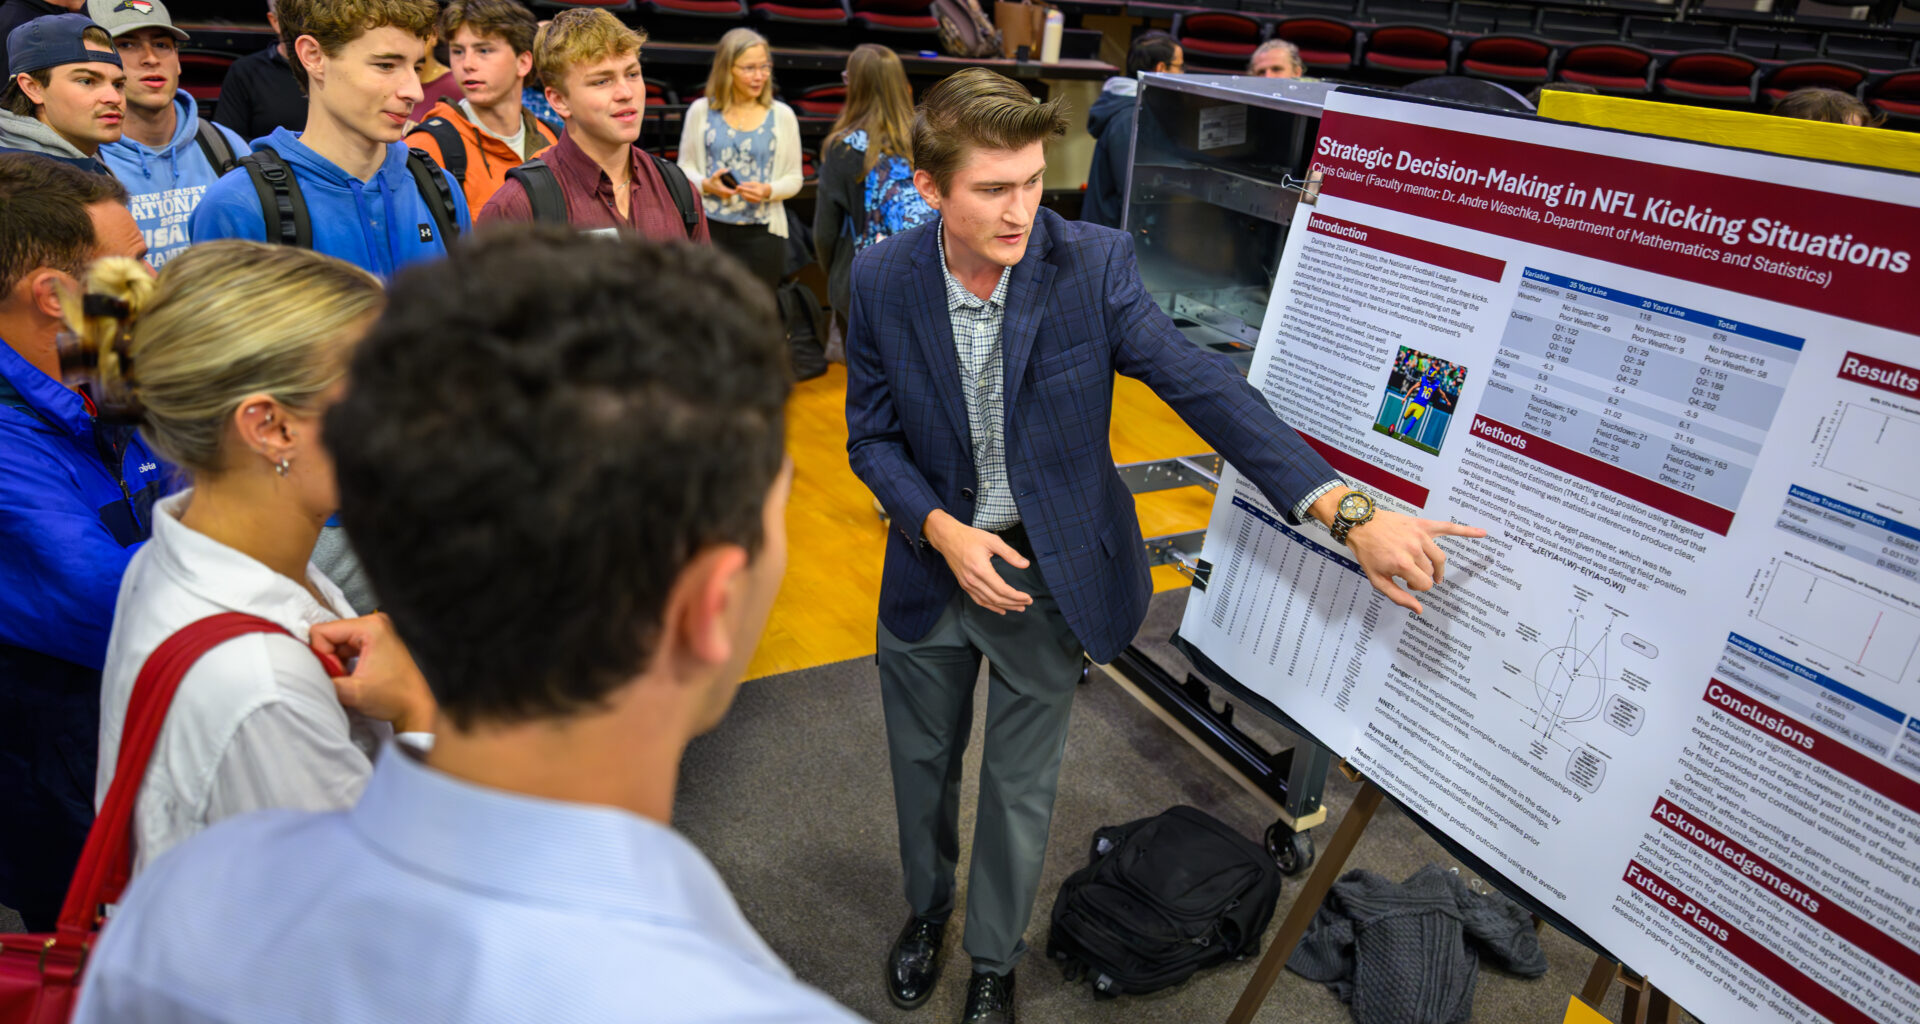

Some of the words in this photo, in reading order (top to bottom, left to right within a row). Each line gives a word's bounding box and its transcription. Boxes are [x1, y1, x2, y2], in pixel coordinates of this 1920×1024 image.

[131, 194, 202, 221] ATIONA
[132, 192, 160, 204] NEW
[162, 185, 206, 200] JERSEY
[1317, 136, 1393, 170] Strategic
[1395, 150, 1564, 207] Decision-Making
[1562, 182, 1587, 208] in
[1590, 187, 1637, 218] NFL
[1642, 197, 1746, 244] Kicking
[1748, 218, 1911, 273] Situations
[1309, 216, 1368, 242] Introduction
[1312, 162, 1336, 176] Chris
[1336, 167, 1366, 182] Guider
[1366, 173, 1404, 193] (Faculty
[1403, 183, 1441, 199] mentor:
[1441, 189, 1456, 203] Dr.
[1456, 193, 1489, 210] Andre
[1490, 199, 1541, 223] Waschka,
[1543, 211, 1615, 238] Department
[1616, 228, 1631, 241] of
[1630, 229, 1720, 261] Mathematics
[1721, 252, 1752, 268] and
[1752, 256, 1832, 289] Statistics)
[1524, 269, 1550, 282] Variable
[1578, 283, 1593, 293] Yard
[1593, 287, 1608, 296] Line
[1518, 292, 1542, 303] Weather
[1642, 300, 1652, 308] 20
[1653, 302, 1669, 313] Yard
[1669, 307, 1685, 317] Line
[1718, 319, 1737, 331] Total
[1842, 357, 1919, 392] Results
[1473, 419, 1527, 450] Methods
[1458, 466, 1484, 482] low-bias
[1484, 478, 1516, 496] estimates.
[1464, 447, 1495, 465] Maximum
[1495, 460, 1528, 479] Likelihood
[1527, 473, 1564, 493] Estimation
[1563, 488, 1589, 505] (TMLE),
[1596, 503, 1622, 518] causal
[1621, 513, 1657, 533] inference
[1657, 528, 1690, 546] method
[1689, 541, 1707, 554] that
[1476, 440, 1486, 450] We
[1486, 446, 1519, 463] estimated
[1518, 458, 1530, 468] the
[1529, 464, 1563, 482] outcomes
[1572, 481, 1600, 498] starting
[1599, 491, 1617, 504] field
[1616, 499, 1647, 516] position
[1647, 512, 1669, 526] using
[1670, 519, 1705, 540] Targeted
[1461, 458, 1492, 475] combines
[1492, 470, 1520, 486] machine
[1519, 481, 1546, 499] learning
[1546, 494, 1562, 504] with
[1562, 500, 1597, 520] statistical
[1596, 514, 1632, 534] inference
[1632, 529, 1640, 538] to
[1640, 534, 1673, 552] produce
[1674, 548, 1695, 563] clear,
[1790, 486, 1821, 502] Average
[1822, 498, 1861, 517] Treatment
[1861, 512, 1886, 526] Effect
[1402, 629, 1428, 648] improves
[1427, 645, 1457, 665] prediction
[1457, 661, 1465, 670] by
[1405, 621, 1435, 641] regression
[1434, 638, 1458, 654] method
[1458, 650, 1470, 662] that
[1408, 611, 1434, 630] GLMNet:
[1439, 630, 1472, 652] regularized
[1730, 634, 1758, 652] Average
[1758, 648, 1794, 669] Treatment
[1794, 665, 1817, 680] Effect
[1708, 684, 1814, 750] Conclusions
[1678, 758, 1747, 802] misspecification.
[1691, 727, 1730, 752] expected
[1729, 748, 1757, 767] points
[1758, 764, 1777, 777] and
[1777, 774, 1820, 801] expected
[1819, 798, 1842, 814] yard
[1842, 809, 1861, 824] line
[1862, 821, 1907, 849] reached.
[1355, 746, 1372, 762] Mean:
[1376, 763, 1395, 779] simple
[1394, 775, 1418, 796] baseline
[1418, 793, 1438, 810] model
[1437, 806, 1450, 819] that
[1449, 816, 1475, 837] predicts
[1475, 834, 1508, 860] outcomes
[1507, 857, 1527, 874] using
[1526, 869, 1538, 882] the
[1538, 879, 1567, 900] average
[1653, 802, 1820, 914] Acknowledgements
[1626, 867, 1730, 942] Future-Plans
[1611, 904, 1646, 930] research
[1645, 928, 1670, 947] paper
[1669, 944, 1681, 956] by
[1681, 952, 1695, 966] the
[1695, 963, 1713, 978] end
[1712, 975, 1724, 984] of
[1723, 981, 1738, 996] the
[1737, 993, 1758, 1011] year.
[1631, 890, 1644, 904] We
[1644, 901, 1659, 914] will
[1658, 910, 1670, 921] be
[1670, 917, 1715, 953] forwarding
[1715, 948, 1739, 968] these
[1740, 966, 1770, 990] results
[1772, 988, 1781, 998] to
[1782, 995, 1810, 1018] kicker
